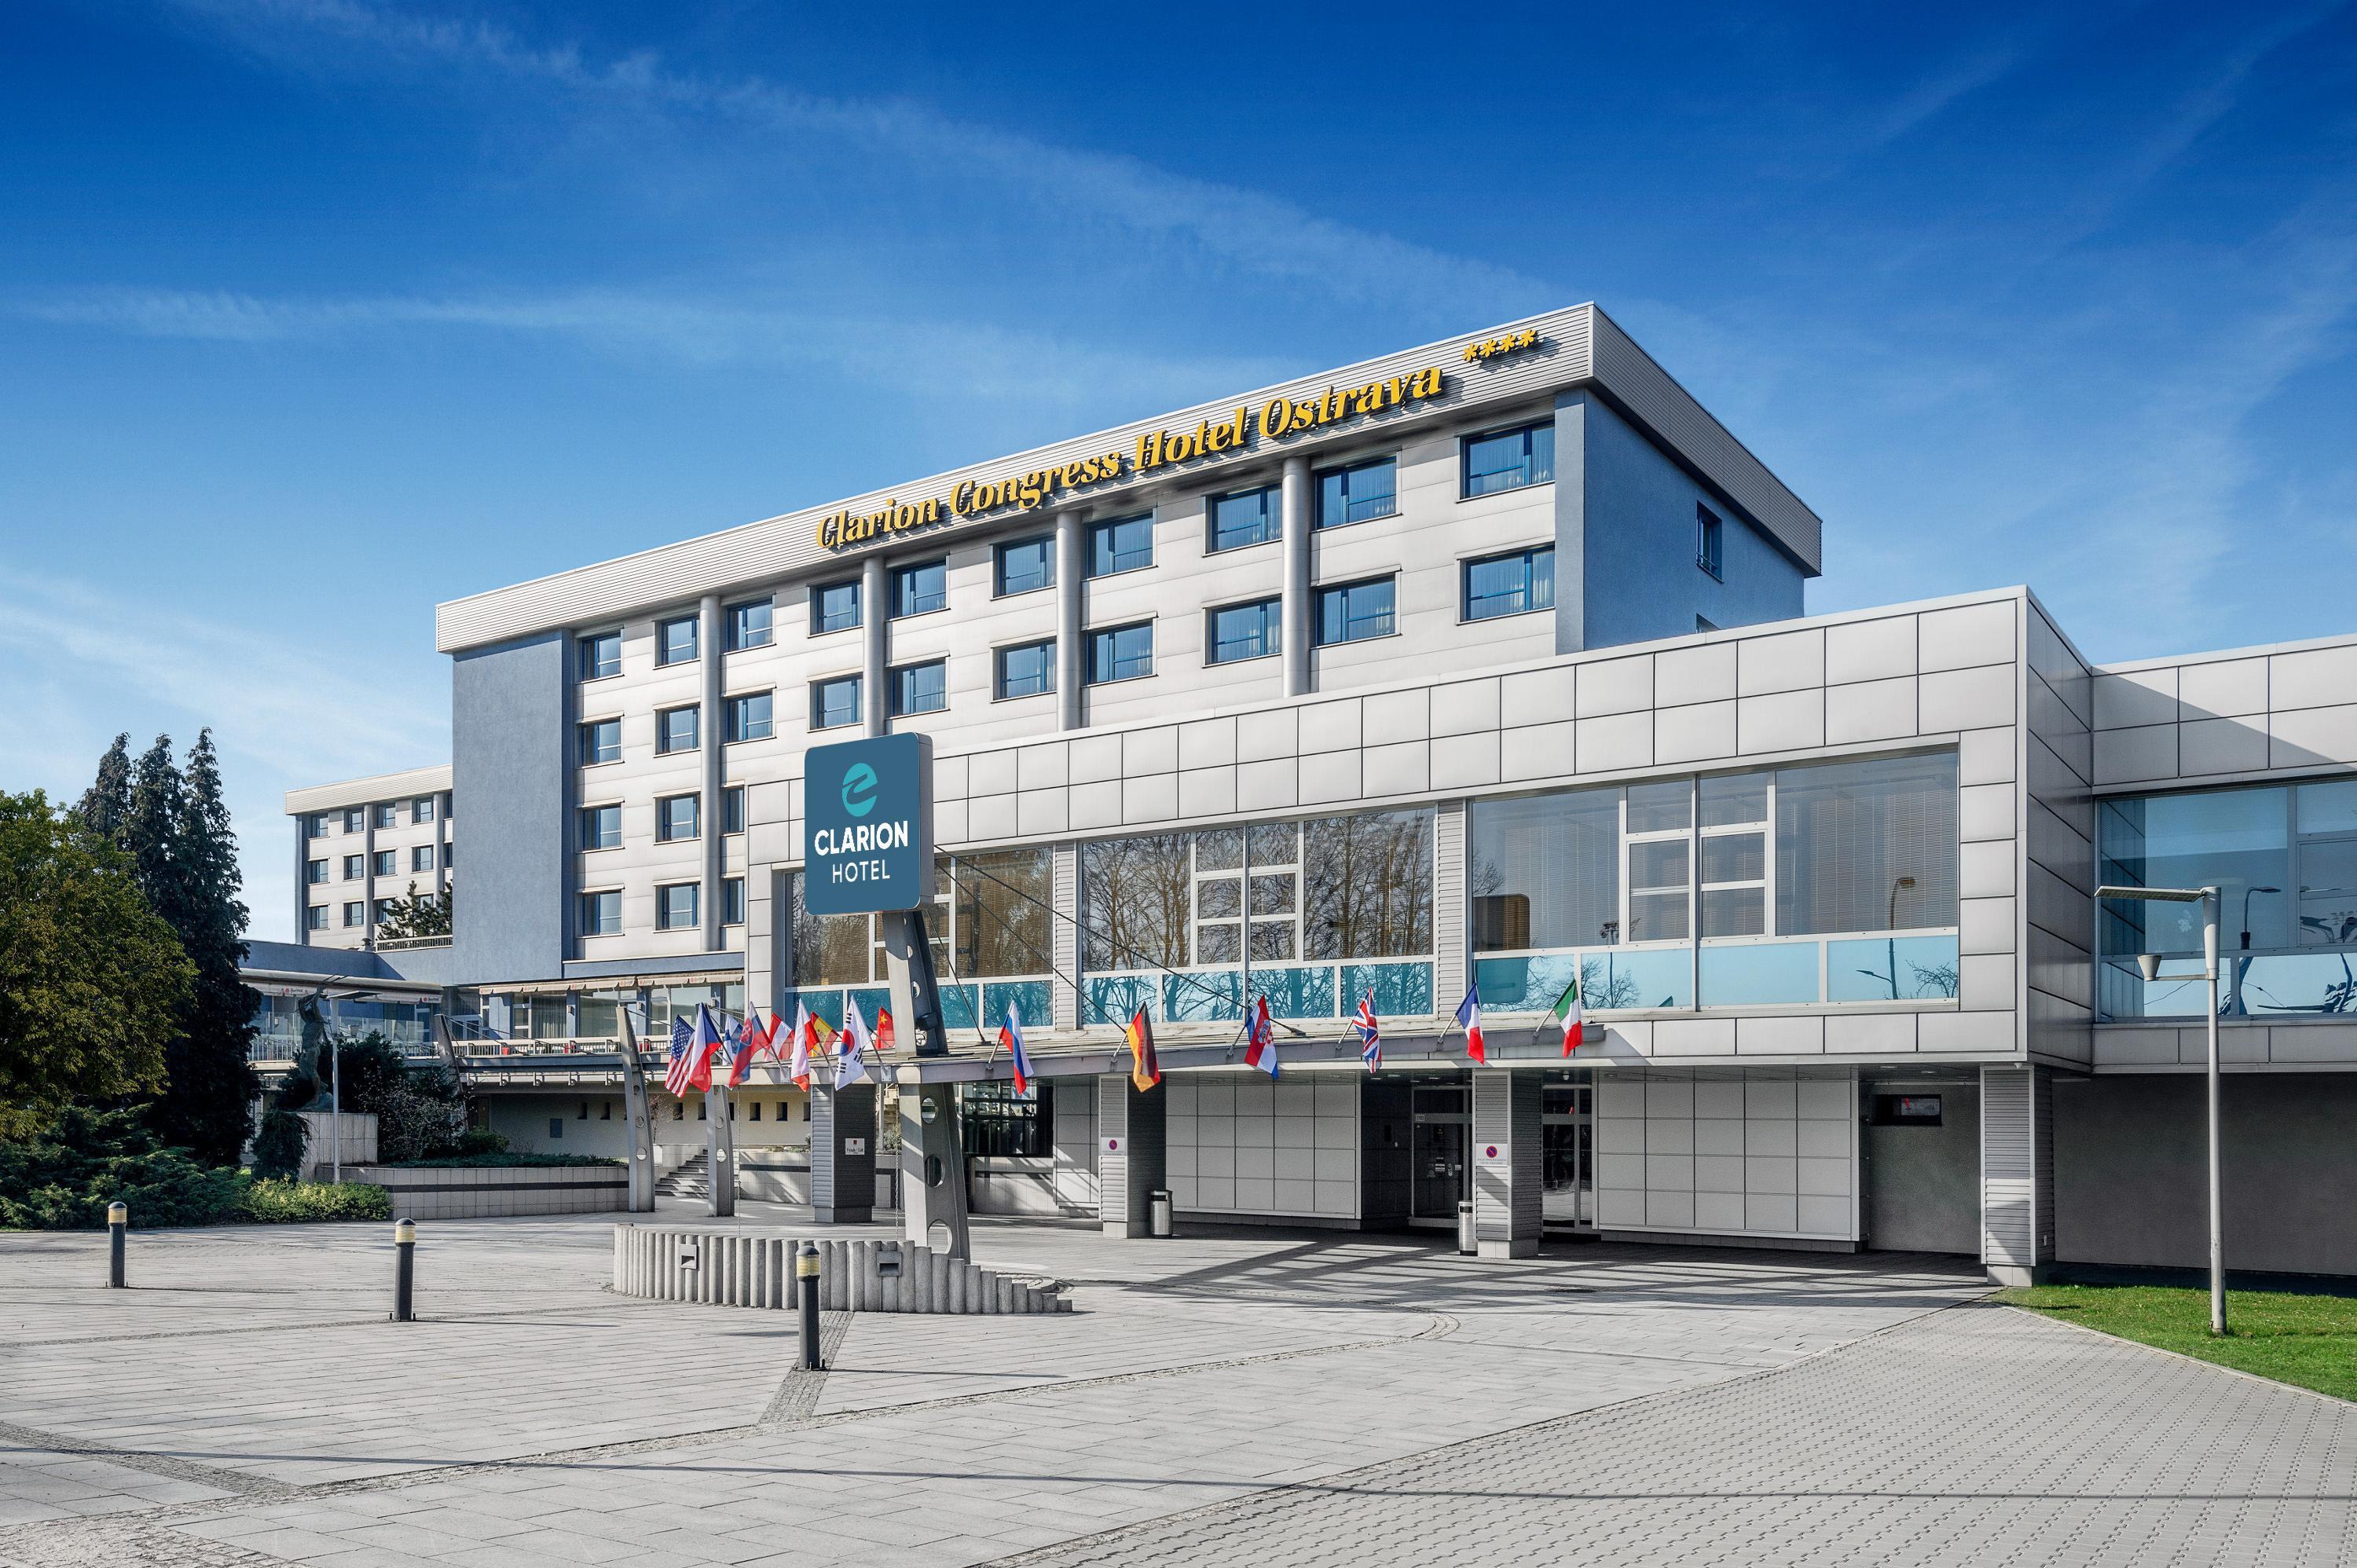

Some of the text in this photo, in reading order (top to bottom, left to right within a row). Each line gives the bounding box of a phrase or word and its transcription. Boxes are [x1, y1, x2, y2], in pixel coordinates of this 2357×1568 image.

[816, 366, 1442, 548] Clarion Congress Hotel Ostrava
[814, 820, 908, 856] CLARION
[832, 859, 890, 884] HOTEL
